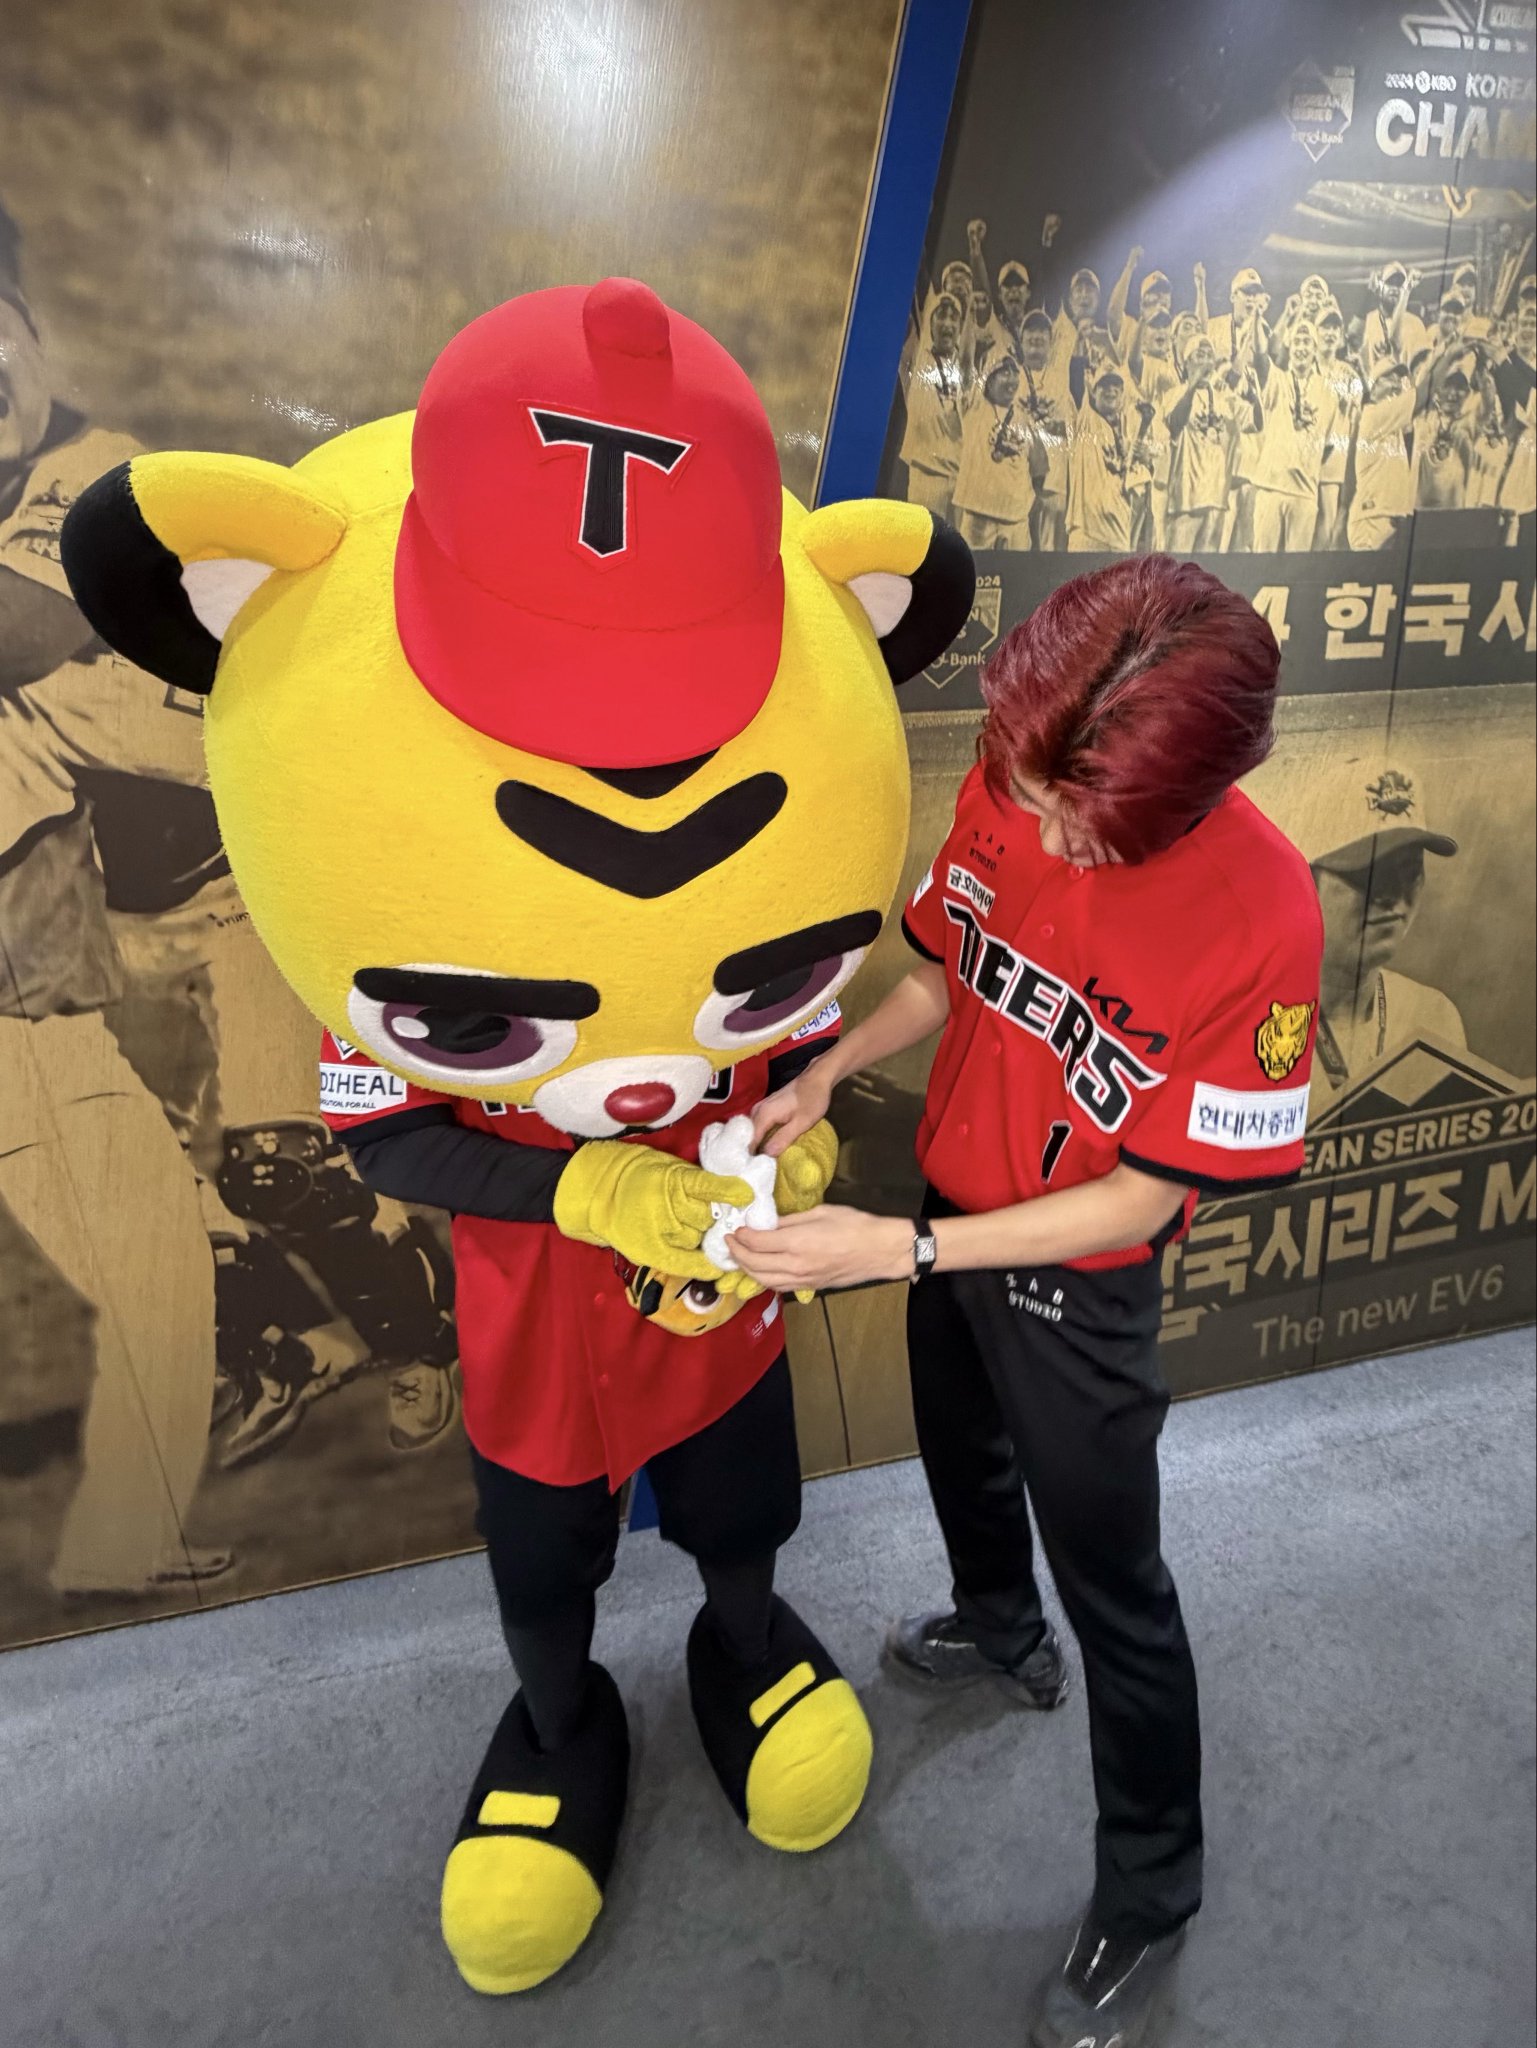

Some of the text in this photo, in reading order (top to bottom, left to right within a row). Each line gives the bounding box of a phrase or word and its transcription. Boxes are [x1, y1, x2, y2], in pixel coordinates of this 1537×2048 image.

[528, 407, 692, 558] T
[975, 575, 1001, 588] 024
[950, 652, 986, 667] Bank
[942, 896, 1168, 1134] TIGERS
[1040, 1120, 1073, 1184] 1
[1301, 1099, 1536, 1176] EAN SERIES 20
[1252, 1314, 1325, 1360] The
[1337, 1292, 1418, 1337] new
[1428, 1264, 1505, 1315] EV6
